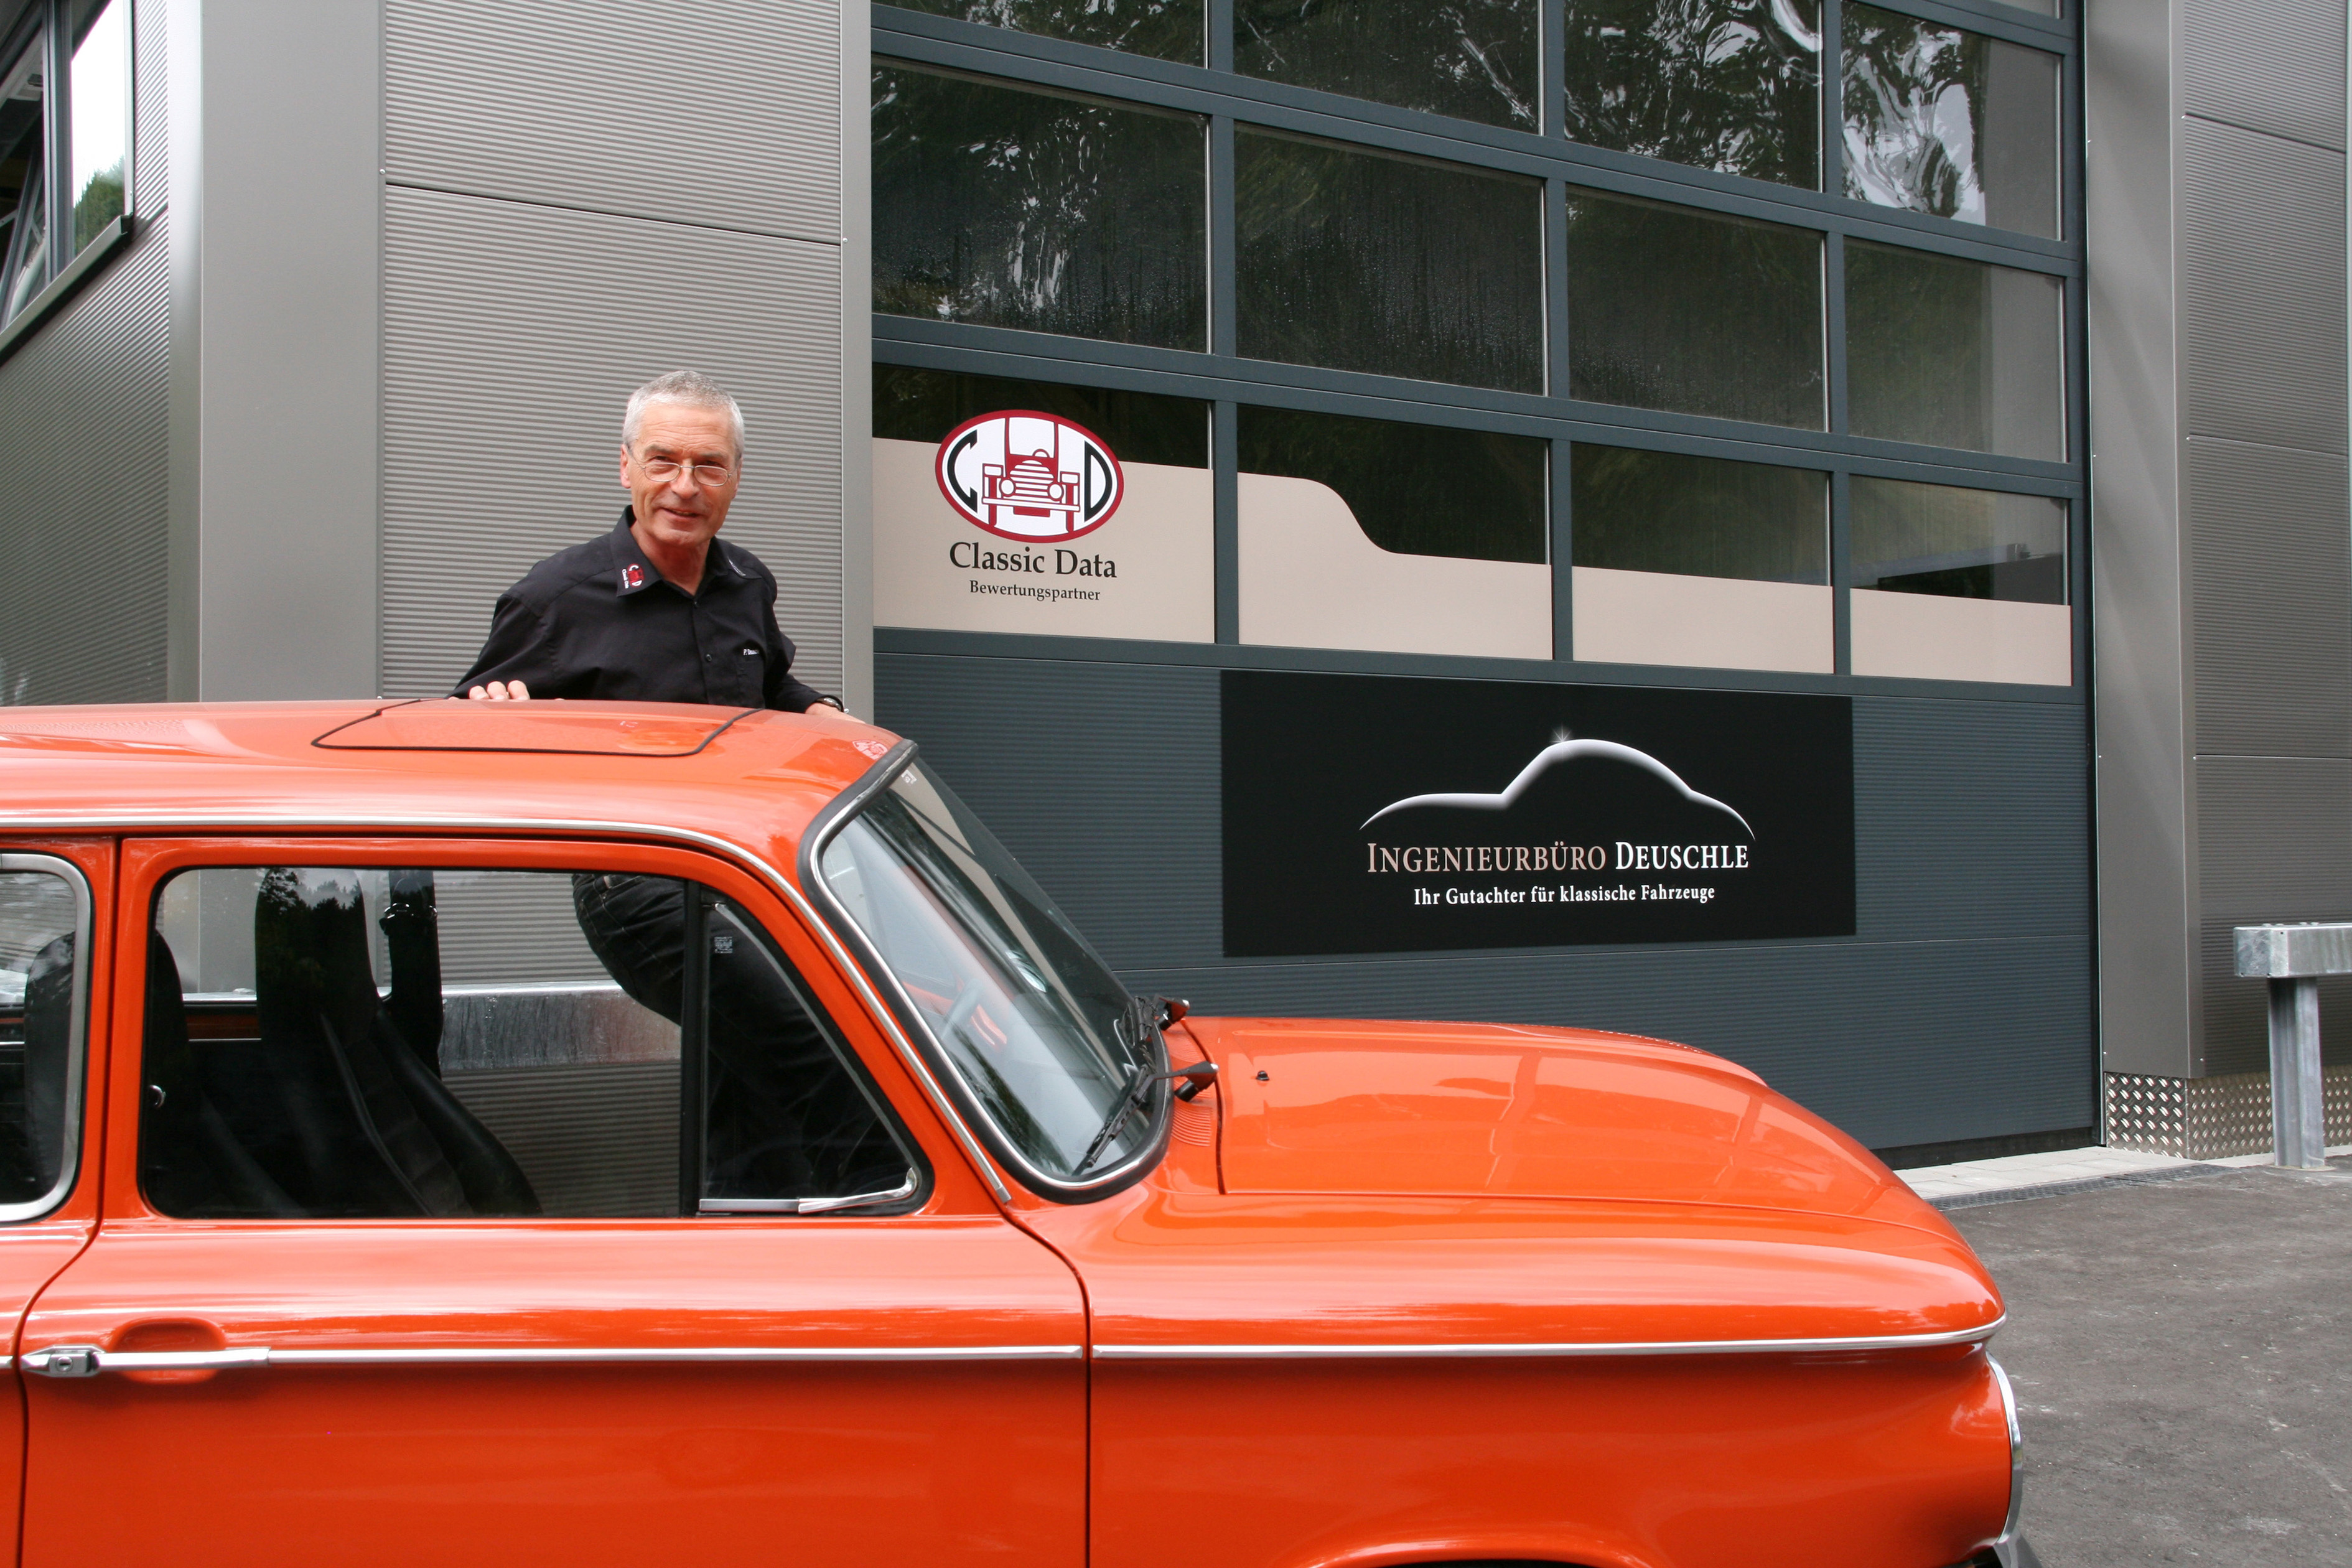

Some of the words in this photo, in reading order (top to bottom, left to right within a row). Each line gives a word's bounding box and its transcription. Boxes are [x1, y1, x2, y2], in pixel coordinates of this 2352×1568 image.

[950, 542, 1045, 573] Classic
[1055, 549, 1117, 577] Data
[969, 580, 1100, 602] Bewertungspartner
[1368, 841, 1606, 872] INGENIEURBÜRO
[1615, 841, 1749, 870] DEUSCHLE
[1414, 888, 1440, 905] Ihr
[1445, 887, 1526, 905] Gutachter
[1531, 885, 1555, 903] für
[1559, 884, 1636, 902] klassische
[1641, 883, 1715, 904] Fahrzeuge
